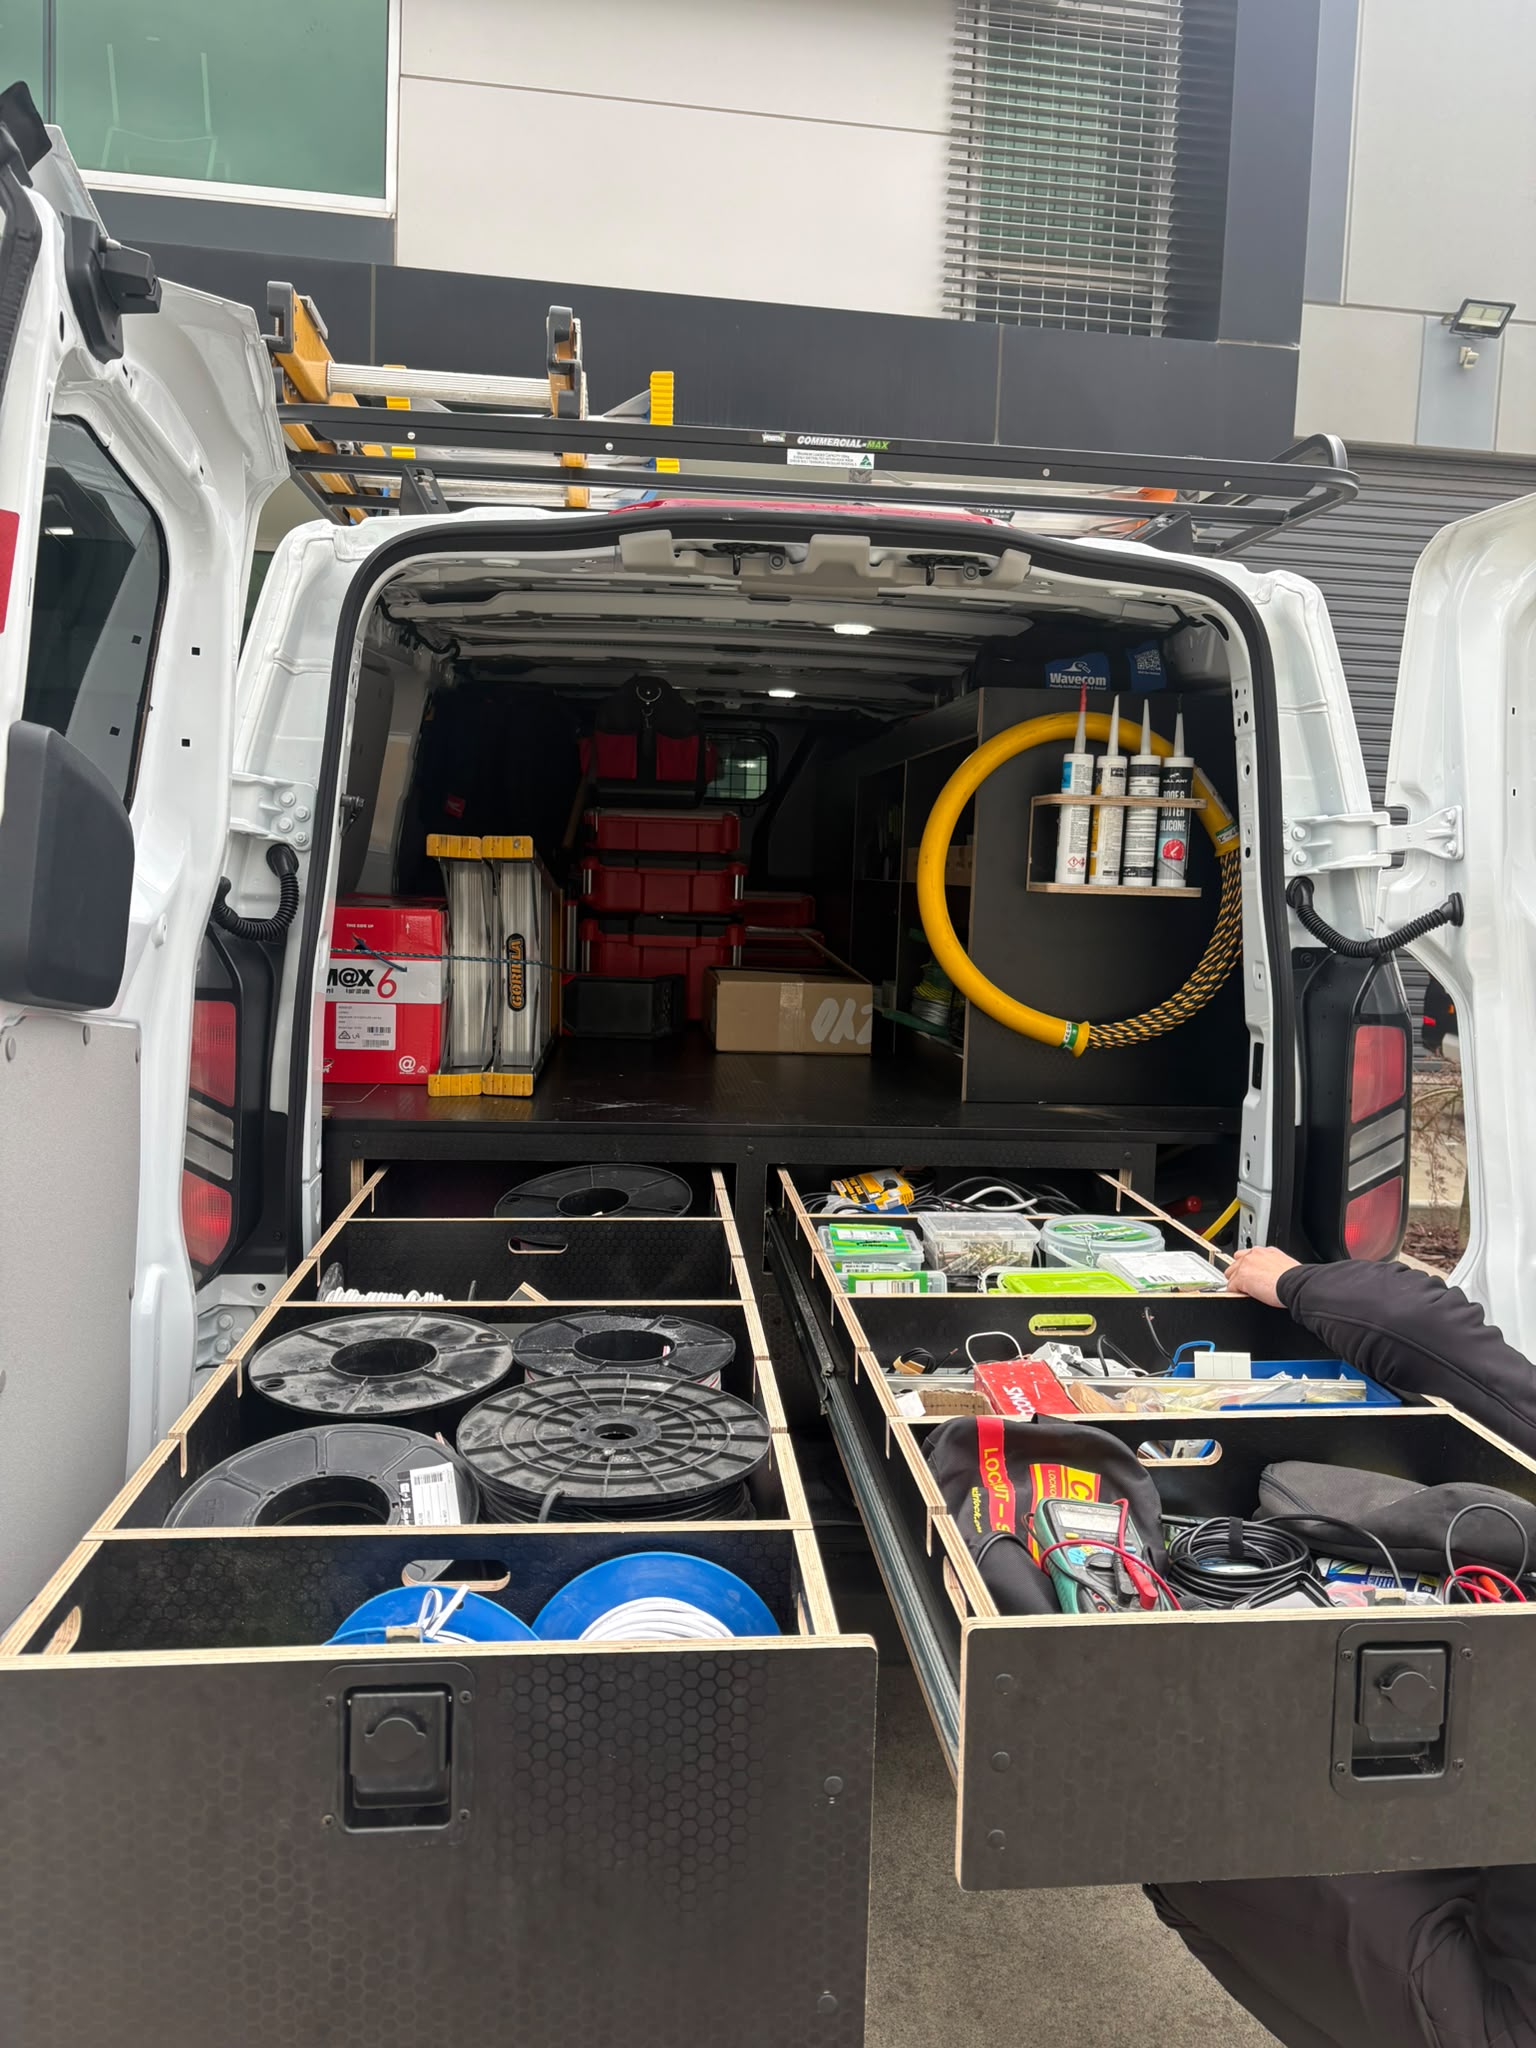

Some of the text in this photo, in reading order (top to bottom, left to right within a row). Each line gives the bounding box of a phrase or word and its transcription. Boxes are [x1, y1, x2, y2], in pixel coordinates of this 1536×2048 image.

[796, 435, 890, 450] COMMERCIAL-MAX
[1049, 672, 1107, 686] Wavecom
[1048, 1470, 1057, 1497] LOCKO
